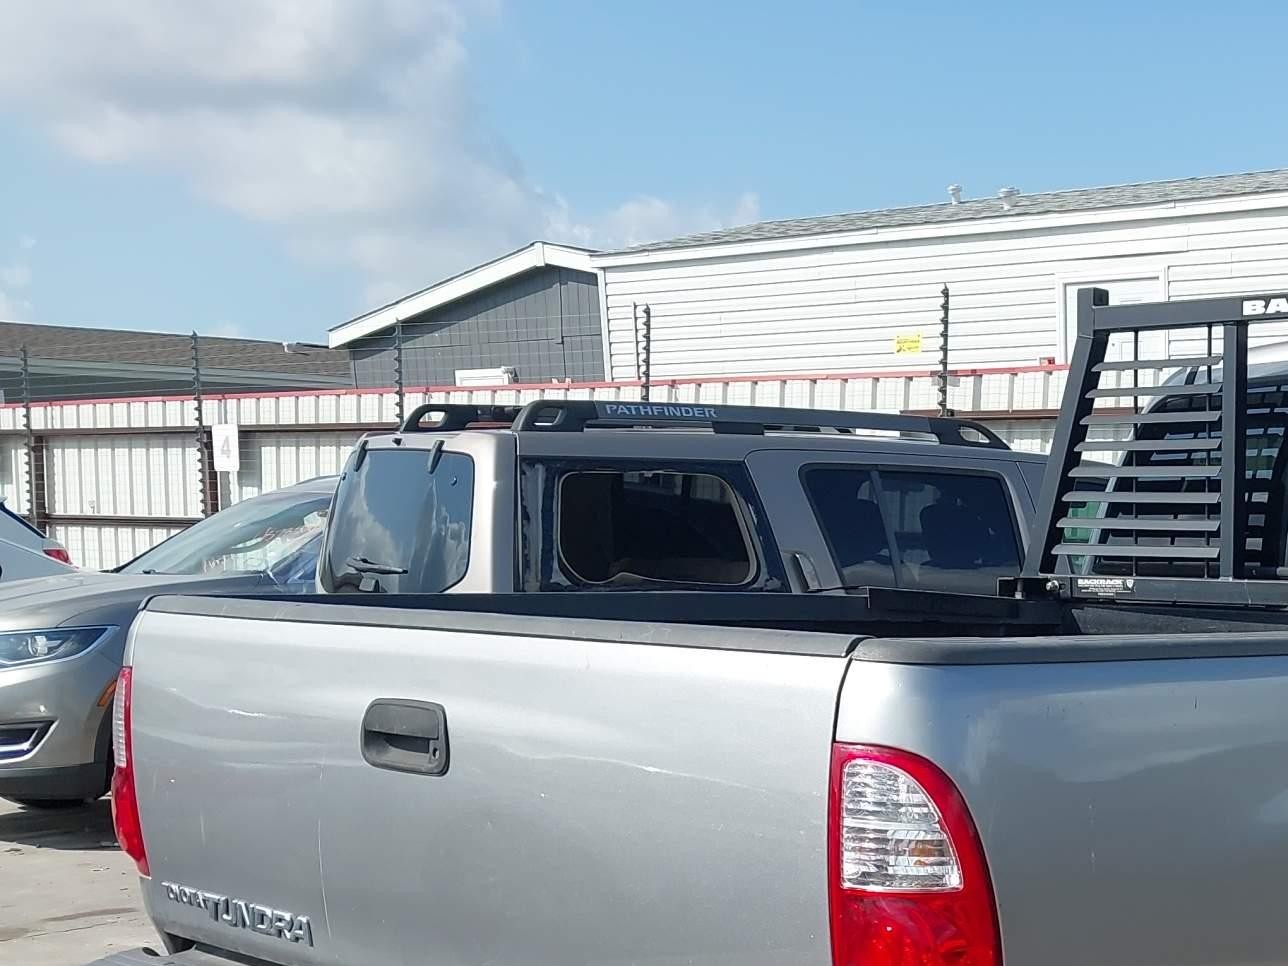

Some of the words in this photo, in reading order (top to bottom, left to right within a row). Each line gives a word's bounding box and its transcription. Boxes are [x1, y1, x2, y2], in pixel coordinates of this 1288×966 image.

[605, 404, 718, 418] PATHFINDER
[220, 435, 231, 459] 4
[203, 891, 314, 947] TUNDRA
